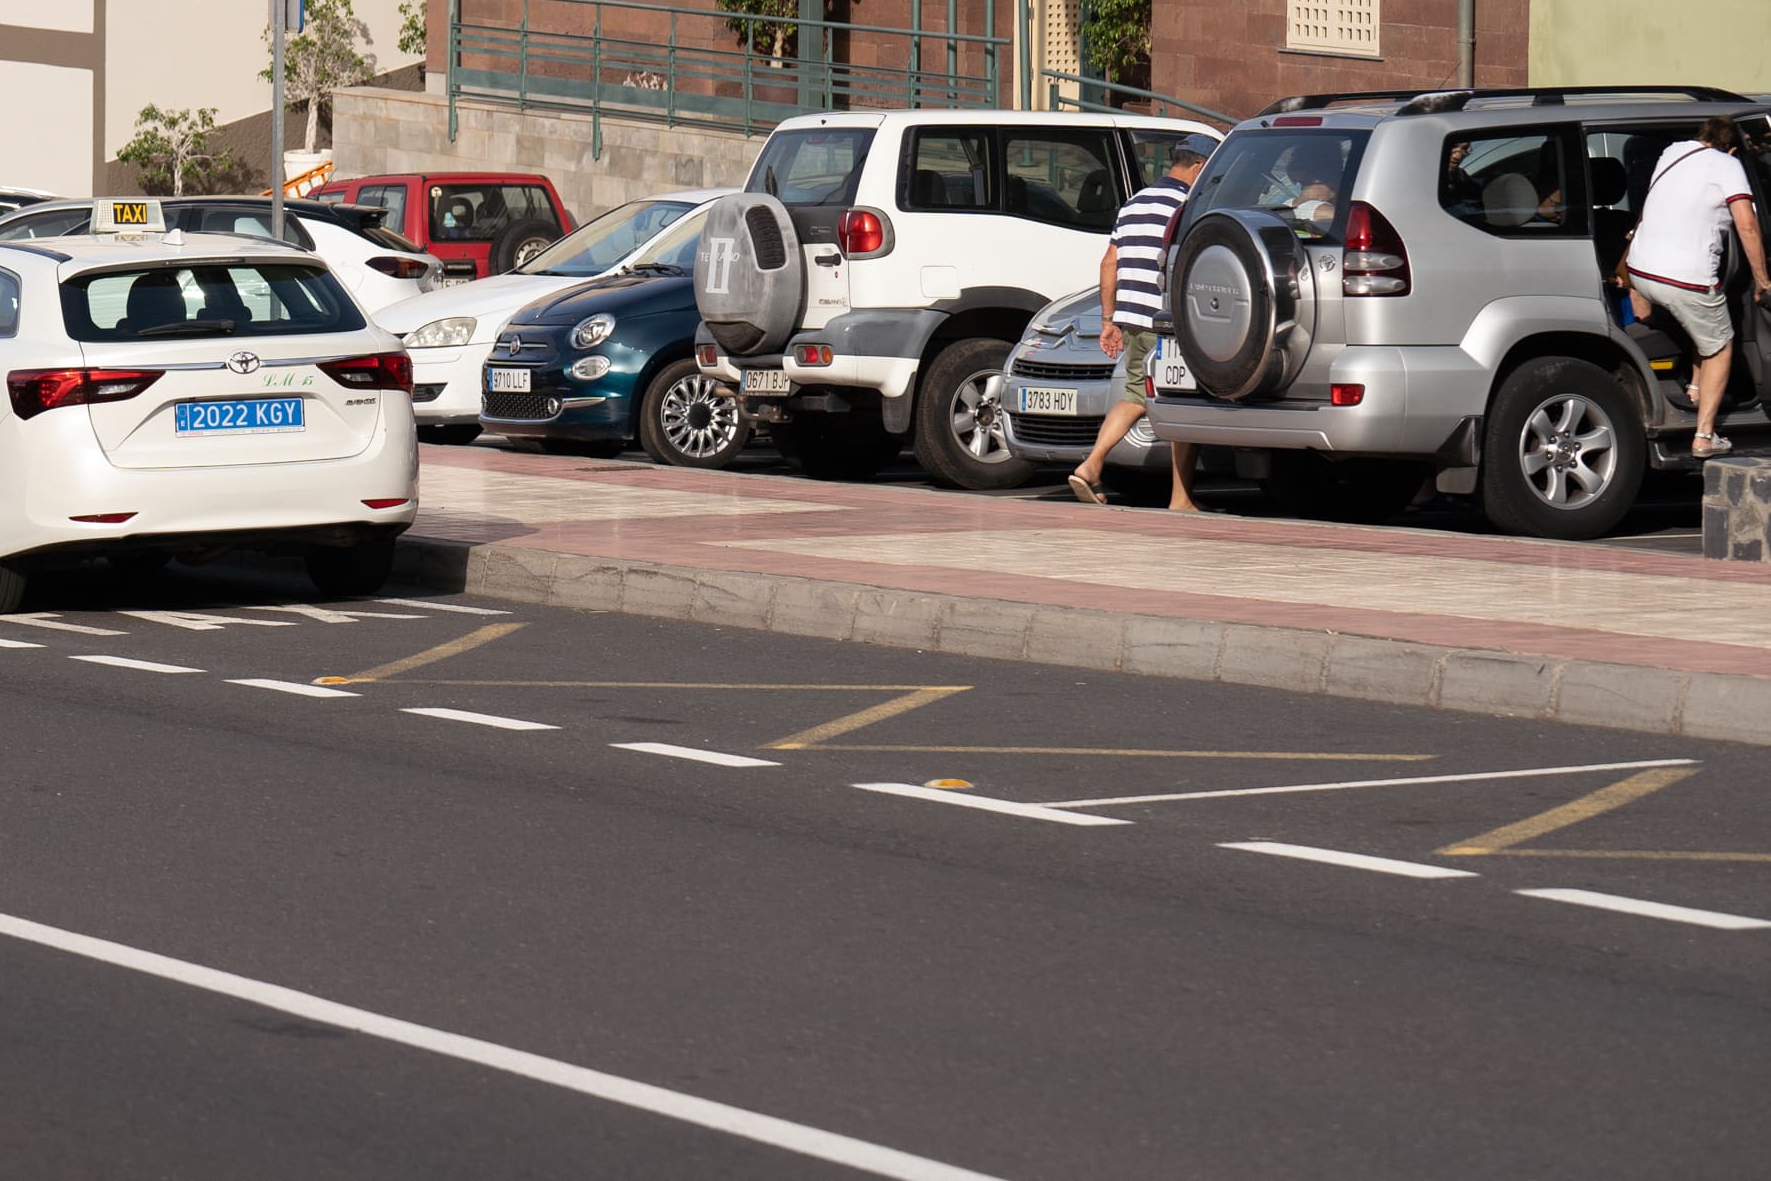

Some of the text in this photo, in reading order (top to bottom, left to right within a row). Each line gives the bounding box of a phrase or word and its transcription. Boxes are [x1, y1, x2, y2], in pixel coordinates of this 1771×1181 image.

[114, 204, 147, 223] TAXI
[700, 251, 741, 263] TEAO
[493, 371, 528, 389] 9710 LLF
[746, 371, 769, 389] 0671
[1166, 365, 1186, 385] CDP
[1028, 391, 1074, 411] 3783 HDY
[193, 404, 248, 428] 2022
[256, 402, 296, 425] KGY
